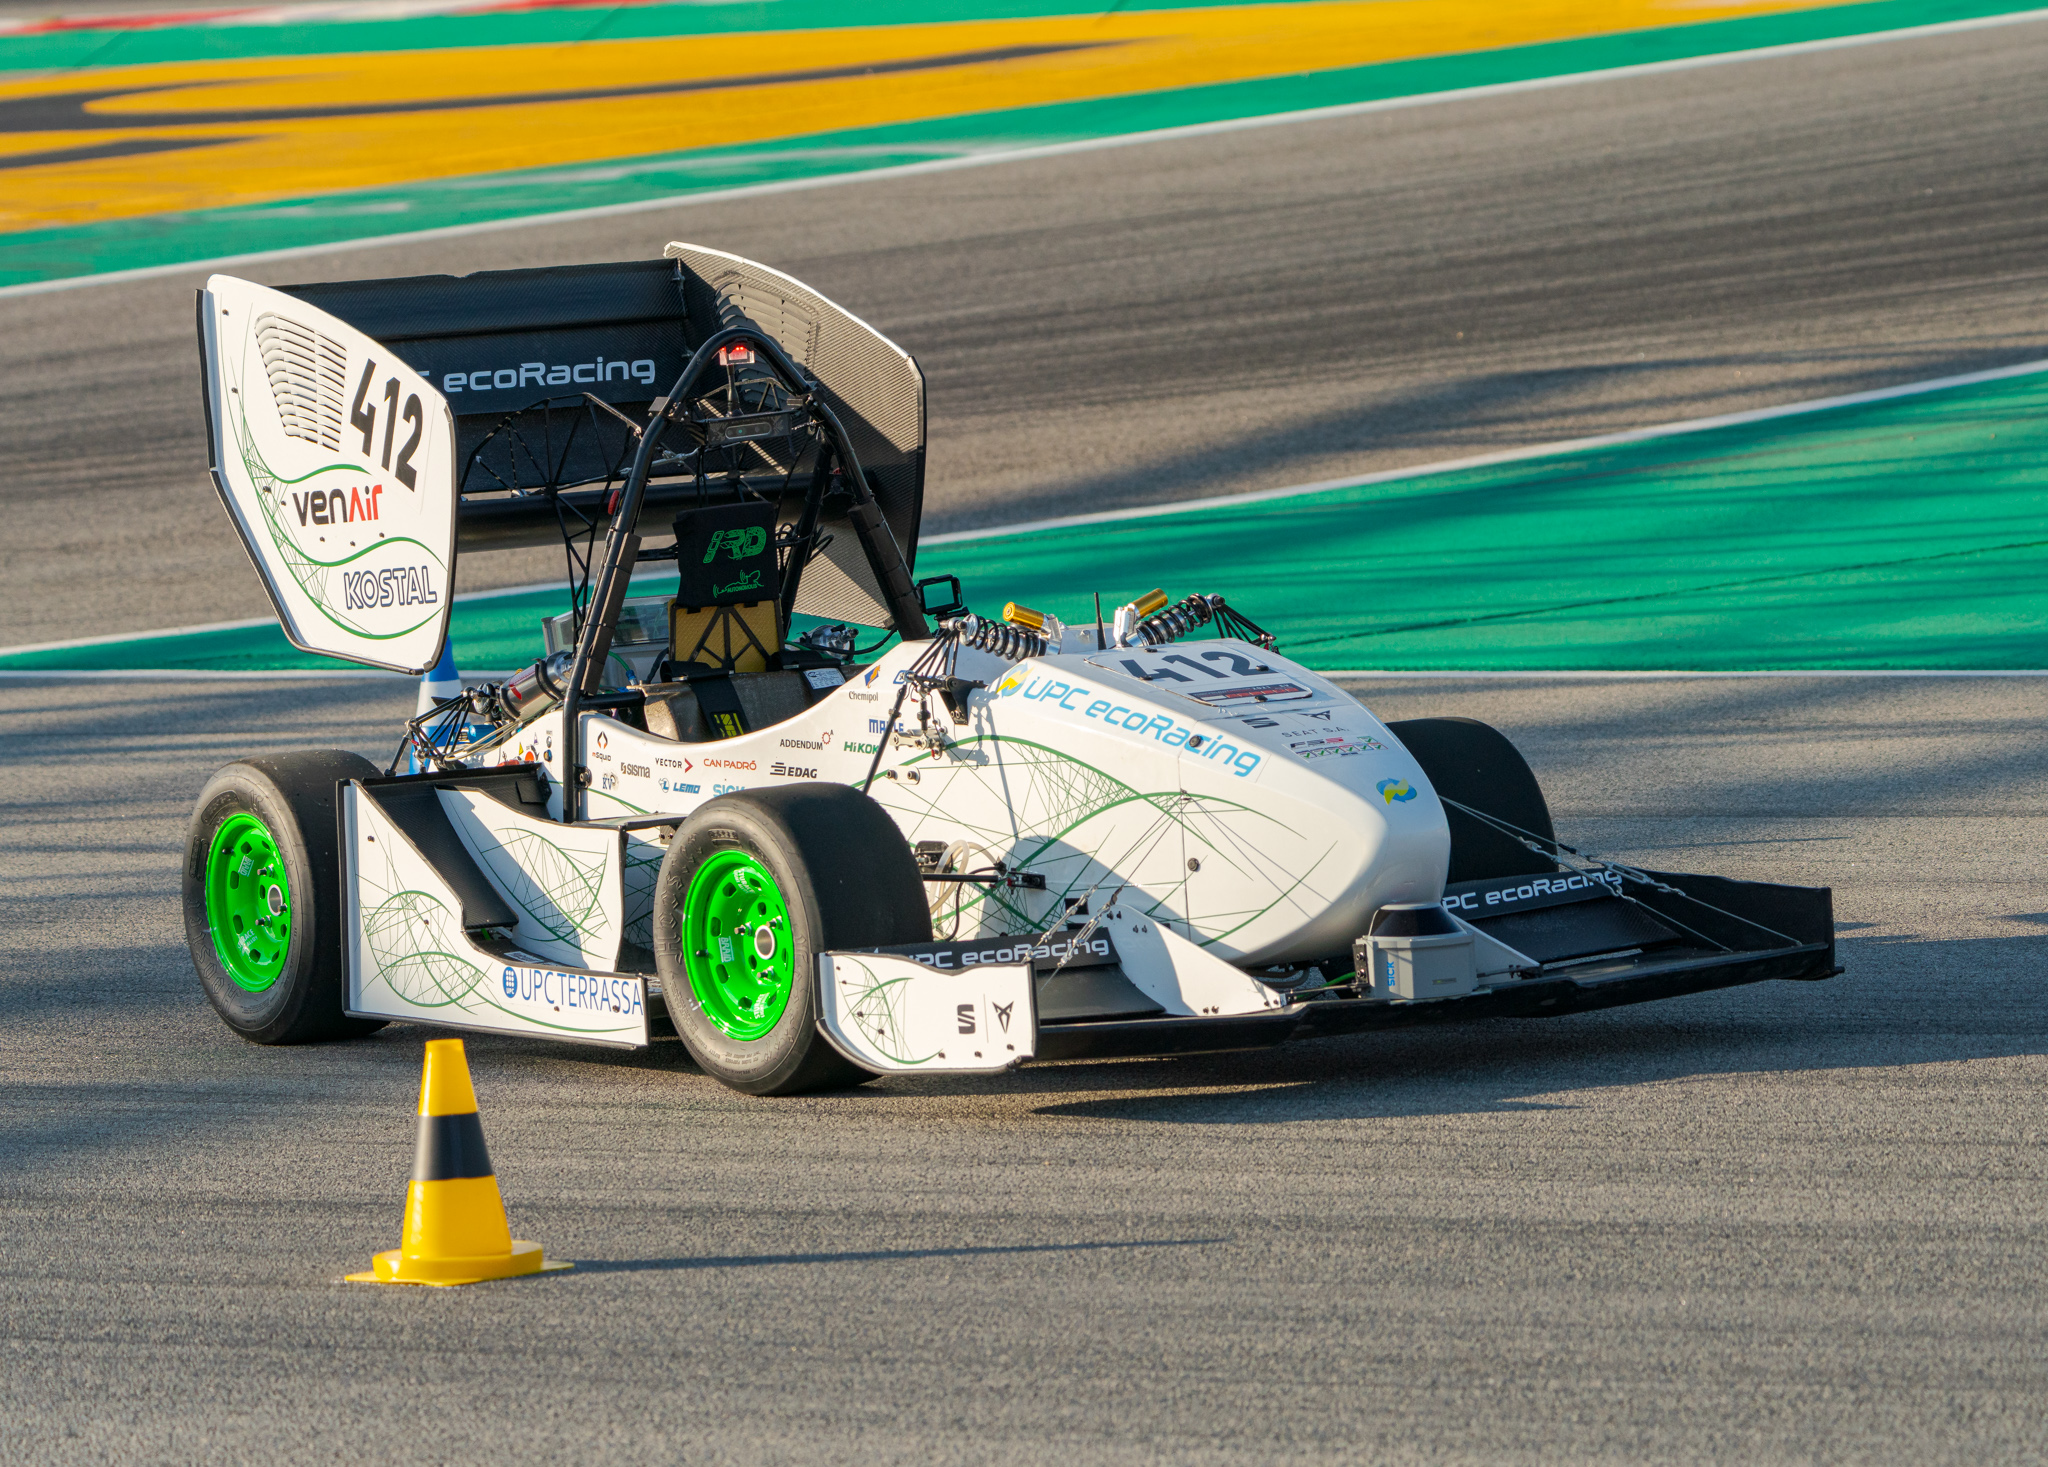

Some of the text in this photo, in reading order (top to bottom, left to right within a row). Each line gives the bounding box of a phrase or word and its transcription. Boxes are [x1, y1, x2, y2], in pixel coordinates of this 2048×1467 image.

[443, 356, 655, 393] ecoRacing
[350, 358, 423, 493] 412
[343, 565, 437, 611] KOSTAL
[1119, 651, 1279, 683] 412
[848, 691, 878, 703] Chemipol
[1023, 676, 1262, 778] UPC ecoRacing
[1281, 728, 1318, 738] SEAT
[780, 739, 823, 751] ADDENDUM
[843, 741, 880, 755] HiKOK
[655, 757, 683, 769] VECTOR
[703, 758, 757, 771] CAN PADRÓ
[787, 766, 818, 779] EDAG
[673, 782, 701, 794] LEMO
[1441, 892, 1478, 913] PC
[719, 936, 733, 964] BRAID
[908, 951, 954, 968] PC
[1387, 961, 1395, 986] SICK
